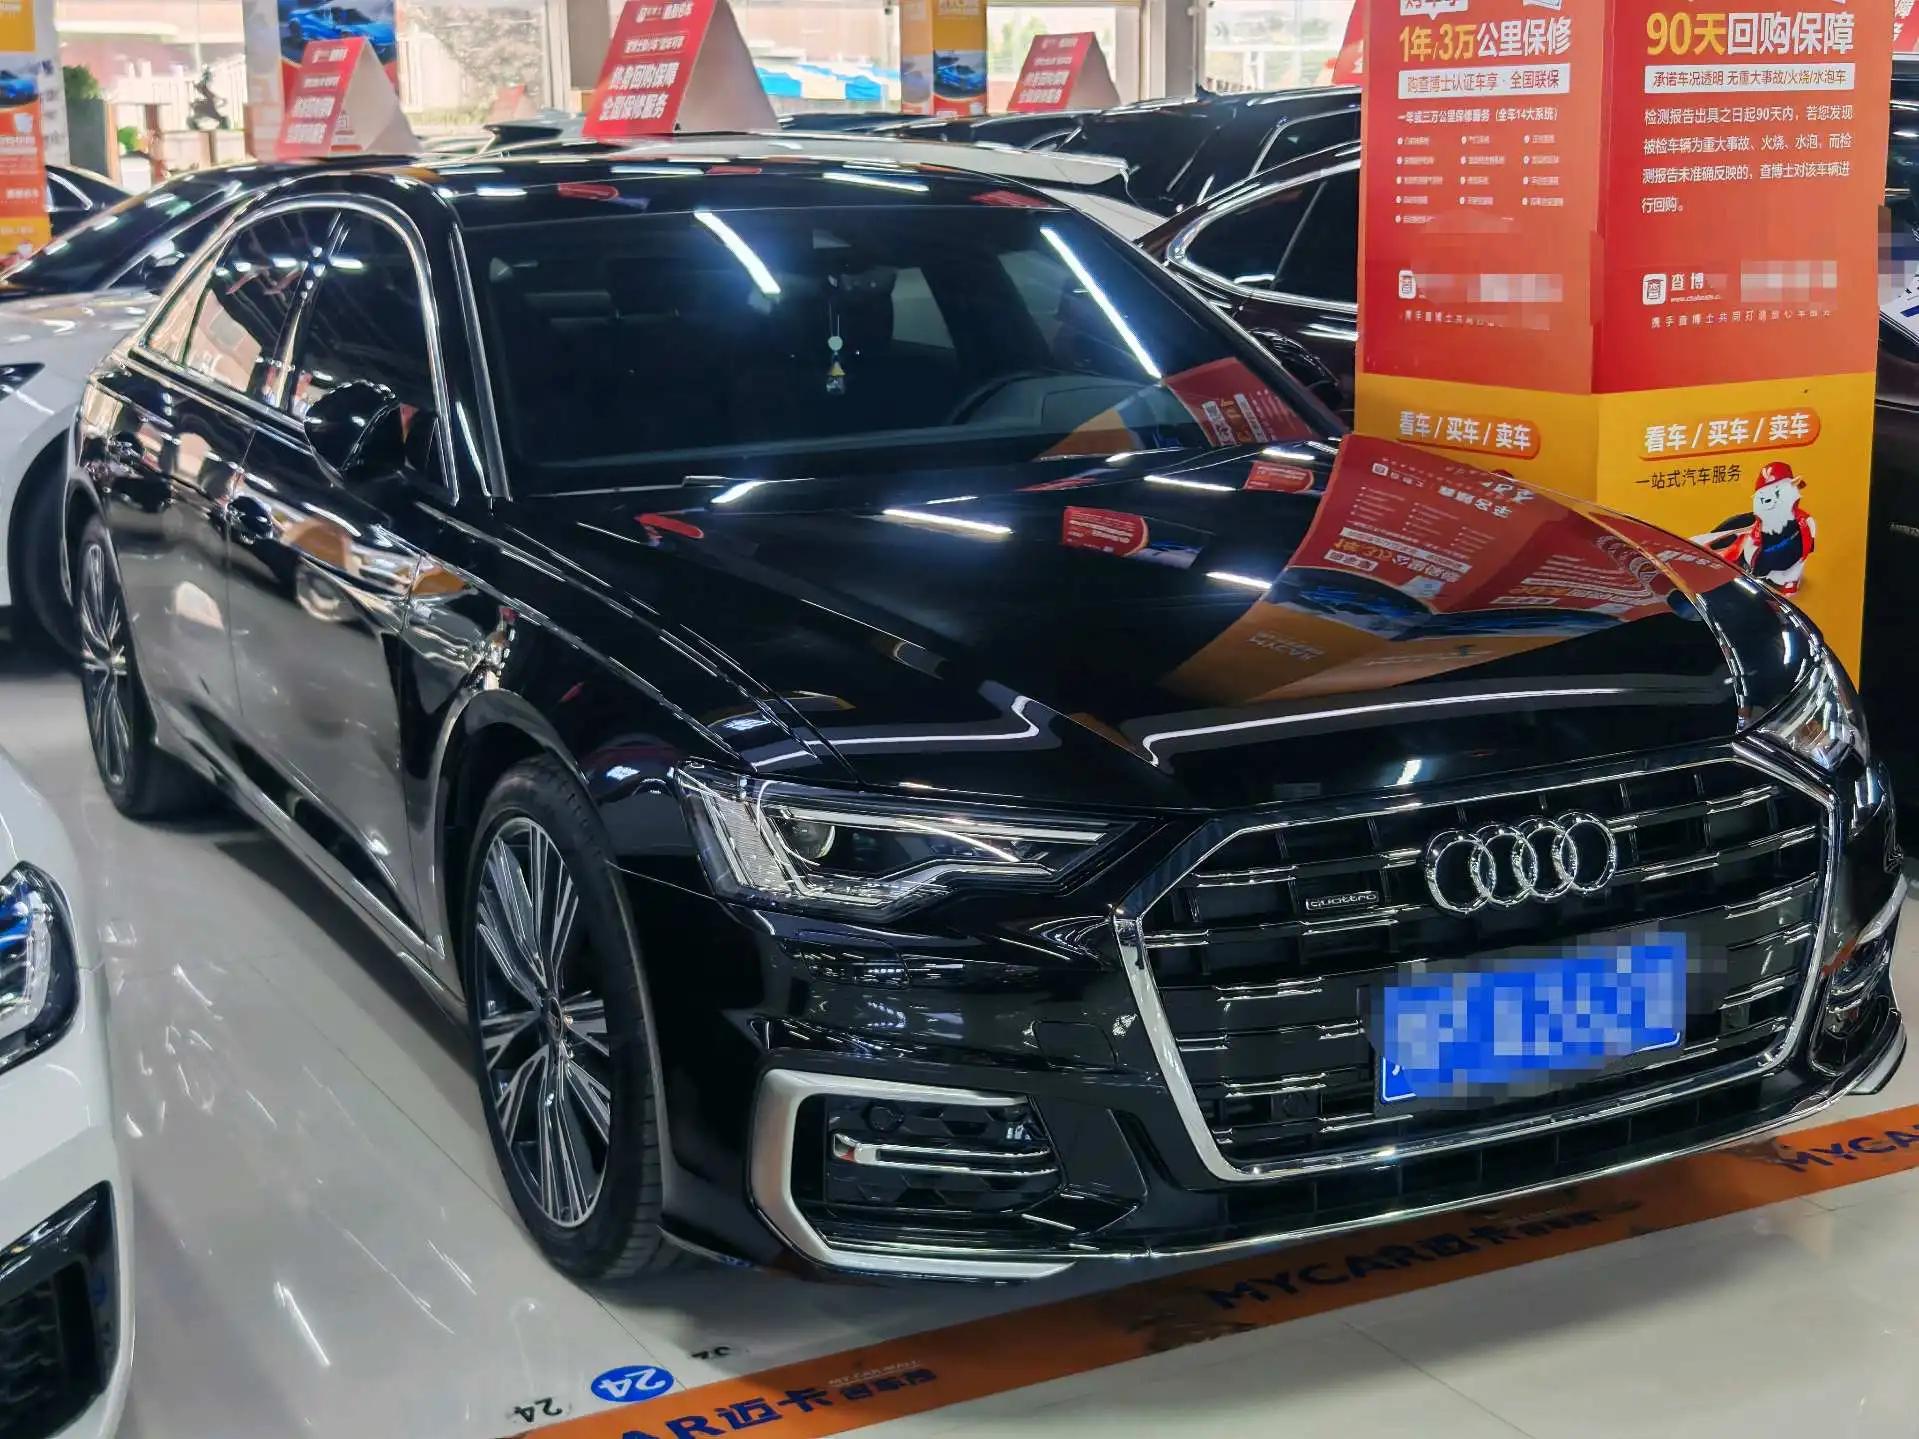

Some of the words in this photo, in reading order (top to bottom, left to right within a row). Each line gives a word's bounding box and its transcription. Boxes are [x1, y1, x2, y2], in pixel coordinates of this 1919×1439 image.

[1400, 17, 1572, 62] 1年/3万公里保修
[1646, 11, 1855, 56] 90天回购保障
[1407, 72, 1498, 93] 购查博士认证车享
[1510, 69, 1560, 89] 全国联保
[1653, 70, 1724, 88] 承诺车况透明
[1727, 69, 1847, 87] 无重大事故/火烧/水泡车
[1641, 196, 1685, 214] 行回购。
[1671, 272, 1714, 291] 查博
[1635, 464, 1742, 489] 一站式汽车服务
[1310, 894, 1377, 907] quattro
[1777, 1122, 1919, 1173] MYCA
[599, 1368, 667, 1398] 24
[514, 1397, 563, 1422] 24
[622, 1389, 833, 1439] R迈卡
